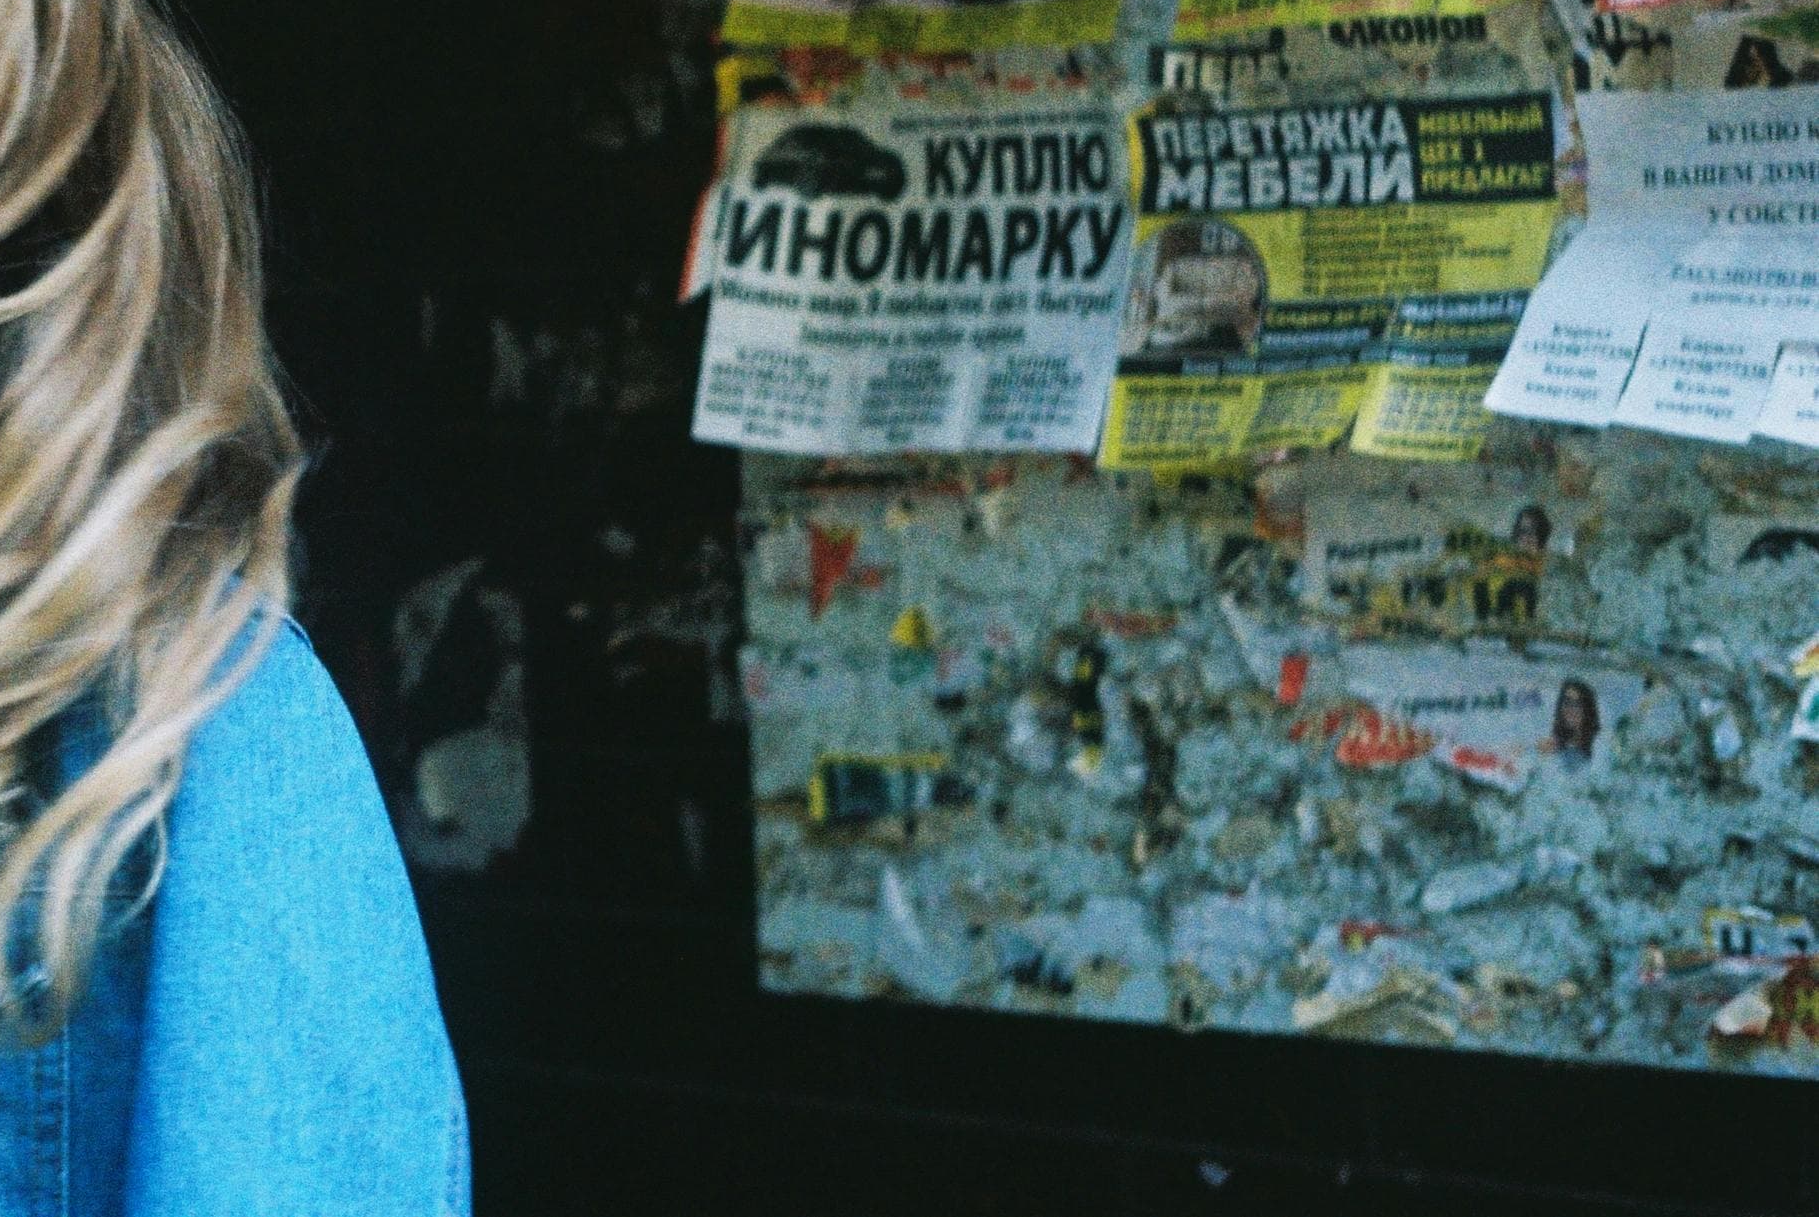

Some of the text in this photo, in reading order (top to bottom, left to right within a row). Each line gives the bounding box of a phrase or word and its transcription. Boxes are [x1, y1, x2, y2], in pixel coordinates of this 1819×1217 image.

[1152, 106, 1411, 160] ПЕРЕТЯЖКА
[1418, 103, 1544, 135] МЕБЕЛЬНЫЙ
[1708, 122, 1800, 145] КУПЛЮ
[923, 134, 1111, 198] КУПЛЮ
[1156, 150, 1415, 212] МЕБЕЛИ
[1643, 168, 1657, 188] В
[1664, 162, 1754, 188] ВАШЕМ
[724, 200, 1124, 282] ИНОМАРКУ
